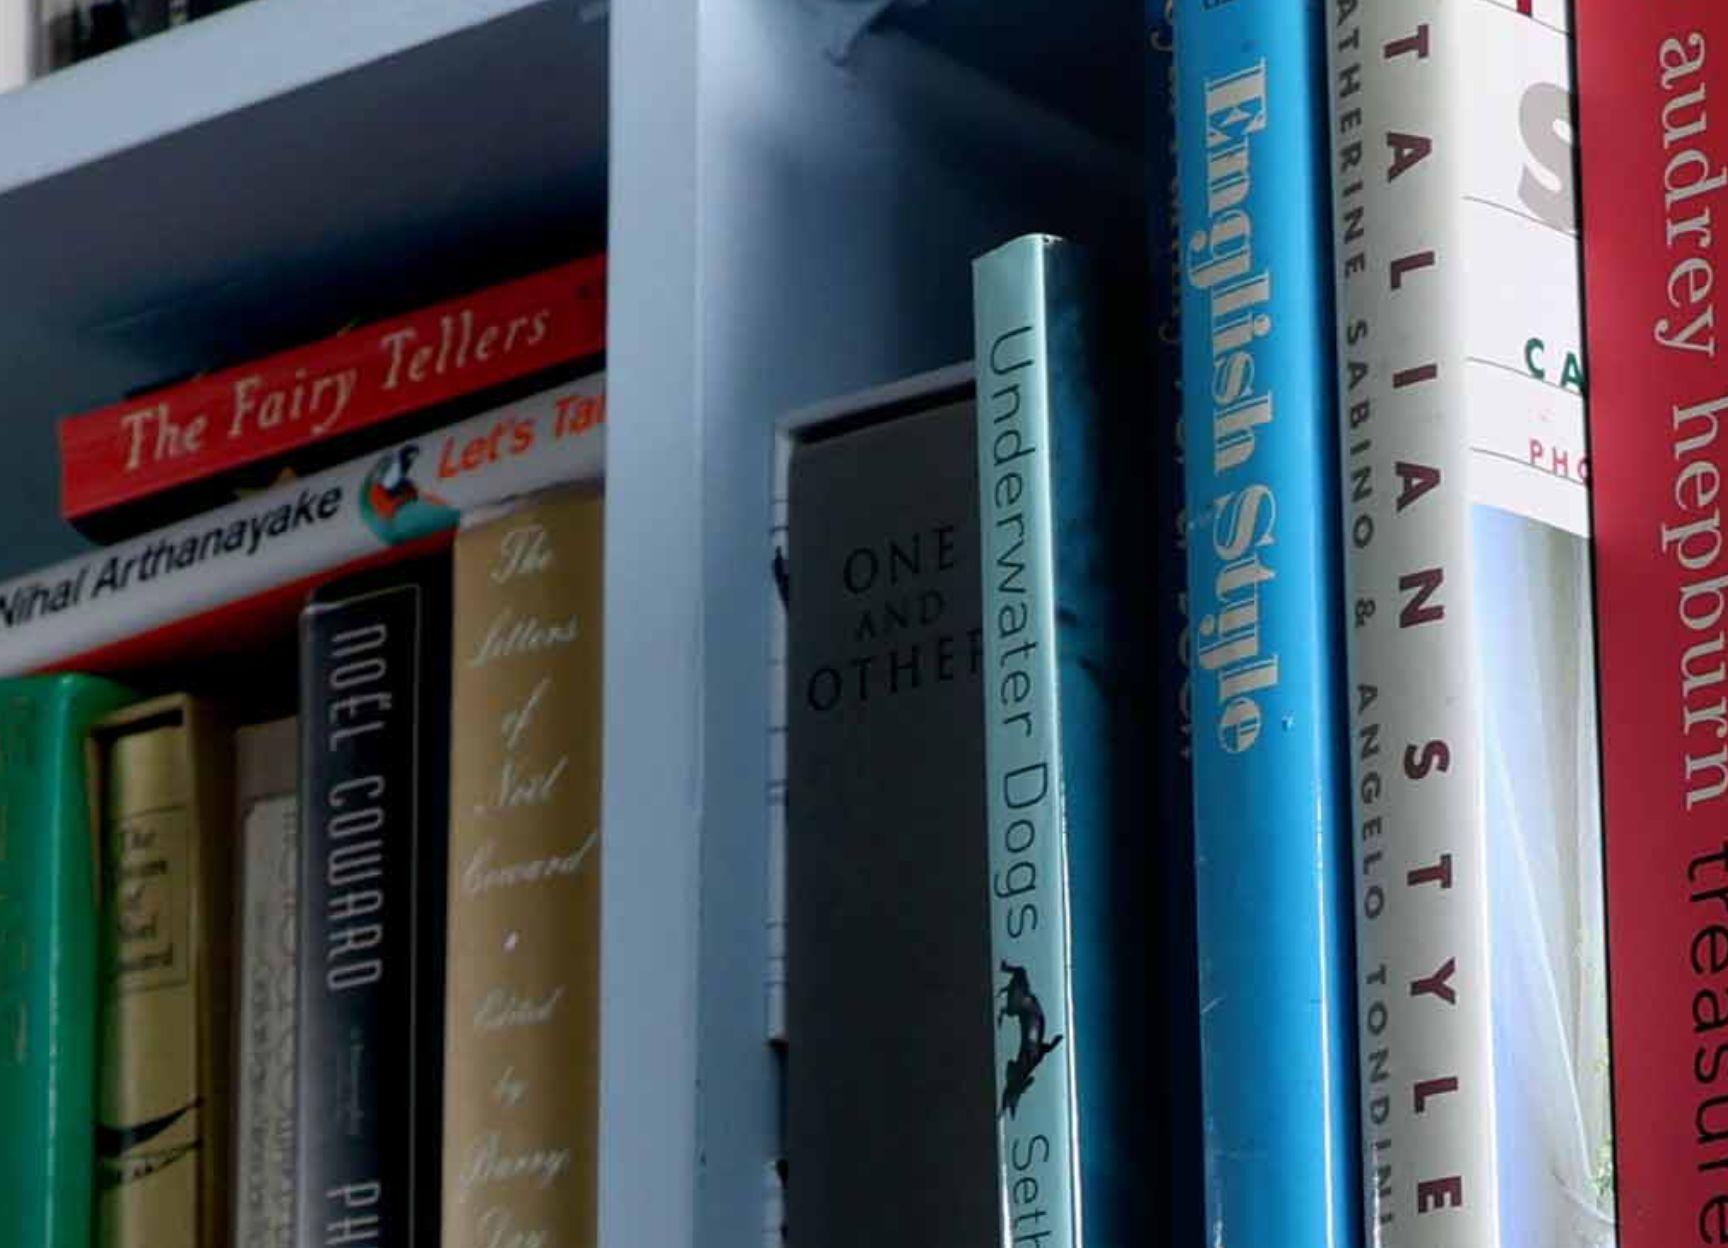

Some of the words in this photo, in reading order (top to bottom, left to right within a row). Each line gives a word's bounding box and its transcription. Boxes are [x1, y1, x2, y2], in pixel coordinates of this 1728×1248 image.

[1181, 56, 1276, 474] English
[1657, 31, 1728, 360] audrey
[120, 408, 207, 470] The
[228, 365, 359, 440] Fairy
[382, 304, 551, 392] Tellers
[1347, 318, 1376, 549] SABINO
[90, 481, 344, 601] Arthanayake
[435, 411, 537, 480] Let's
[1197, 483, 1280, 753] Style
[1355, 596, 1376, 629] &
[327, 773, 386, 992] COWARD
[1356, 682, 1386, 920] ANGELO
